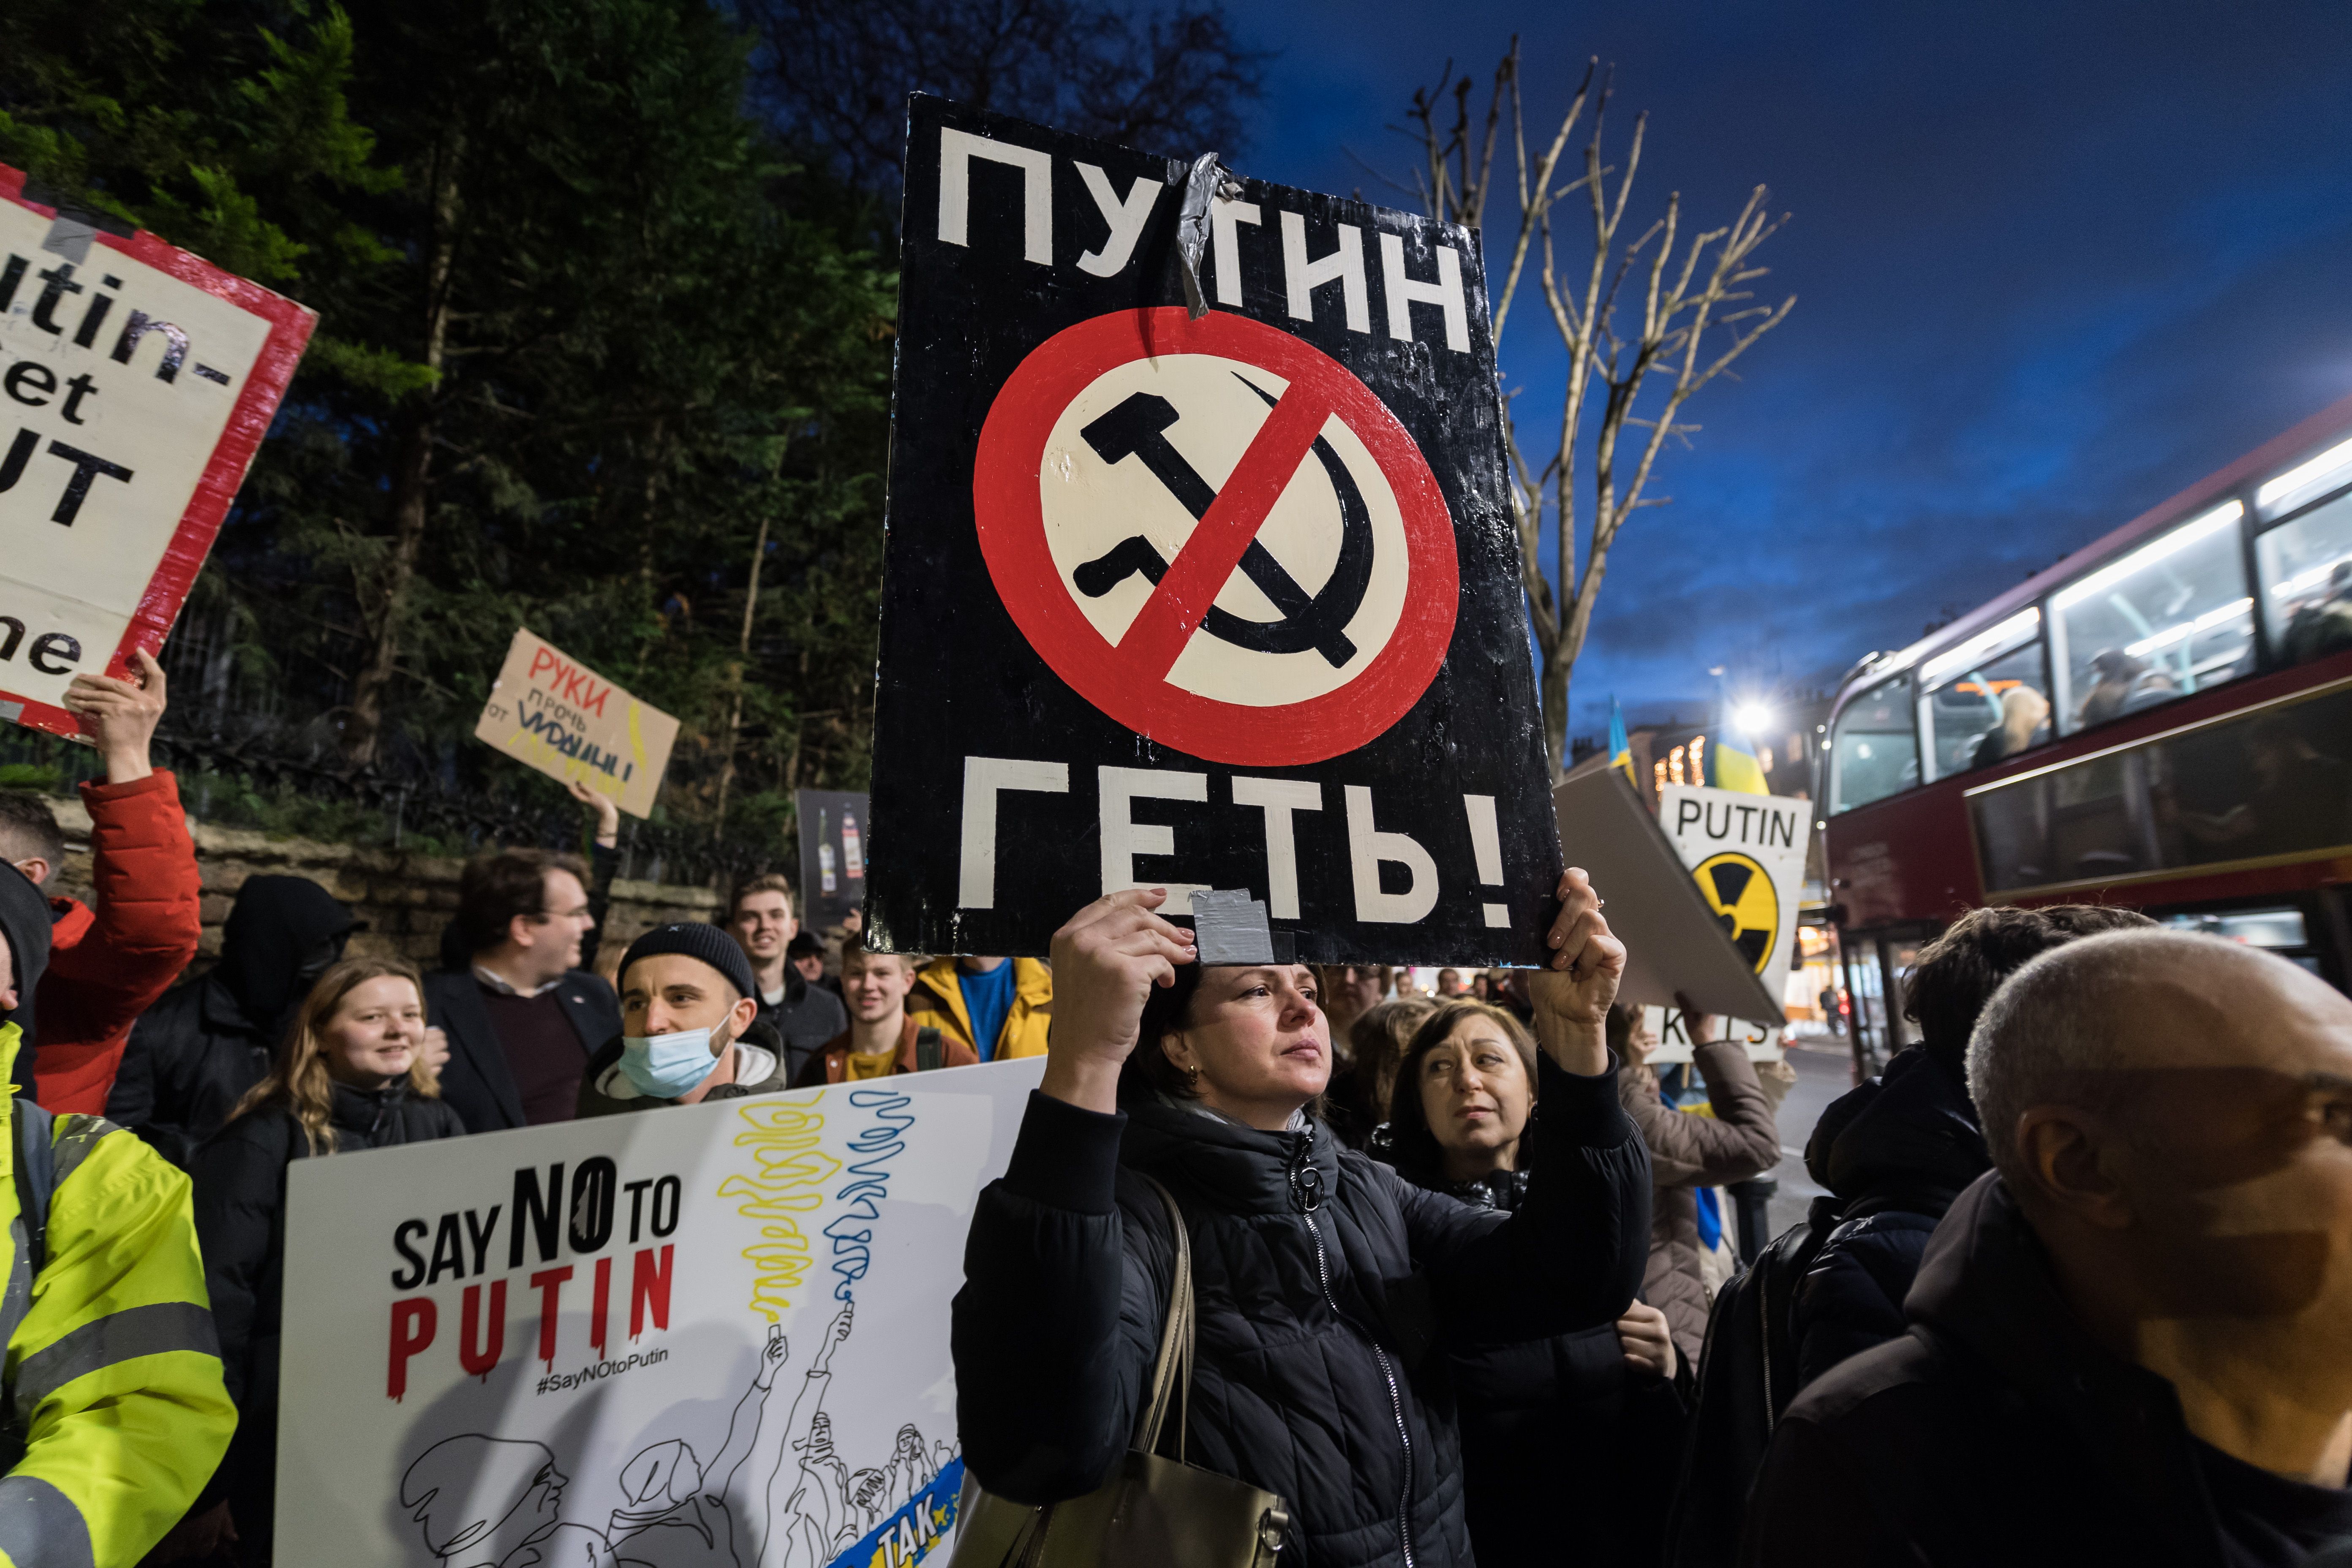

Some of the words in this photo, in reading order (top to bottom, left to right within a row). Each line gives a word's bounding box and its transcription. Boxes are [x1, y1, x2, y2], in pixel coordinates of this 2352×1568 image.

[938, 126, 1471, 353] ПУТИН
[528, 646, 611, 718] РУКИ
[958, 756, 1511, 928] ГЕТЬ!
[1677, 799, 1797, 848] PUTIN
[391, 1204, 502, 1290] SAY
[507, 1155, 617, 1270] NO
[623, 1174, 681, 1244] TO
[387, 1244, 675, 1403] PUTIN
[536, 1348, 668, 1395] #SayNOtoPutin
